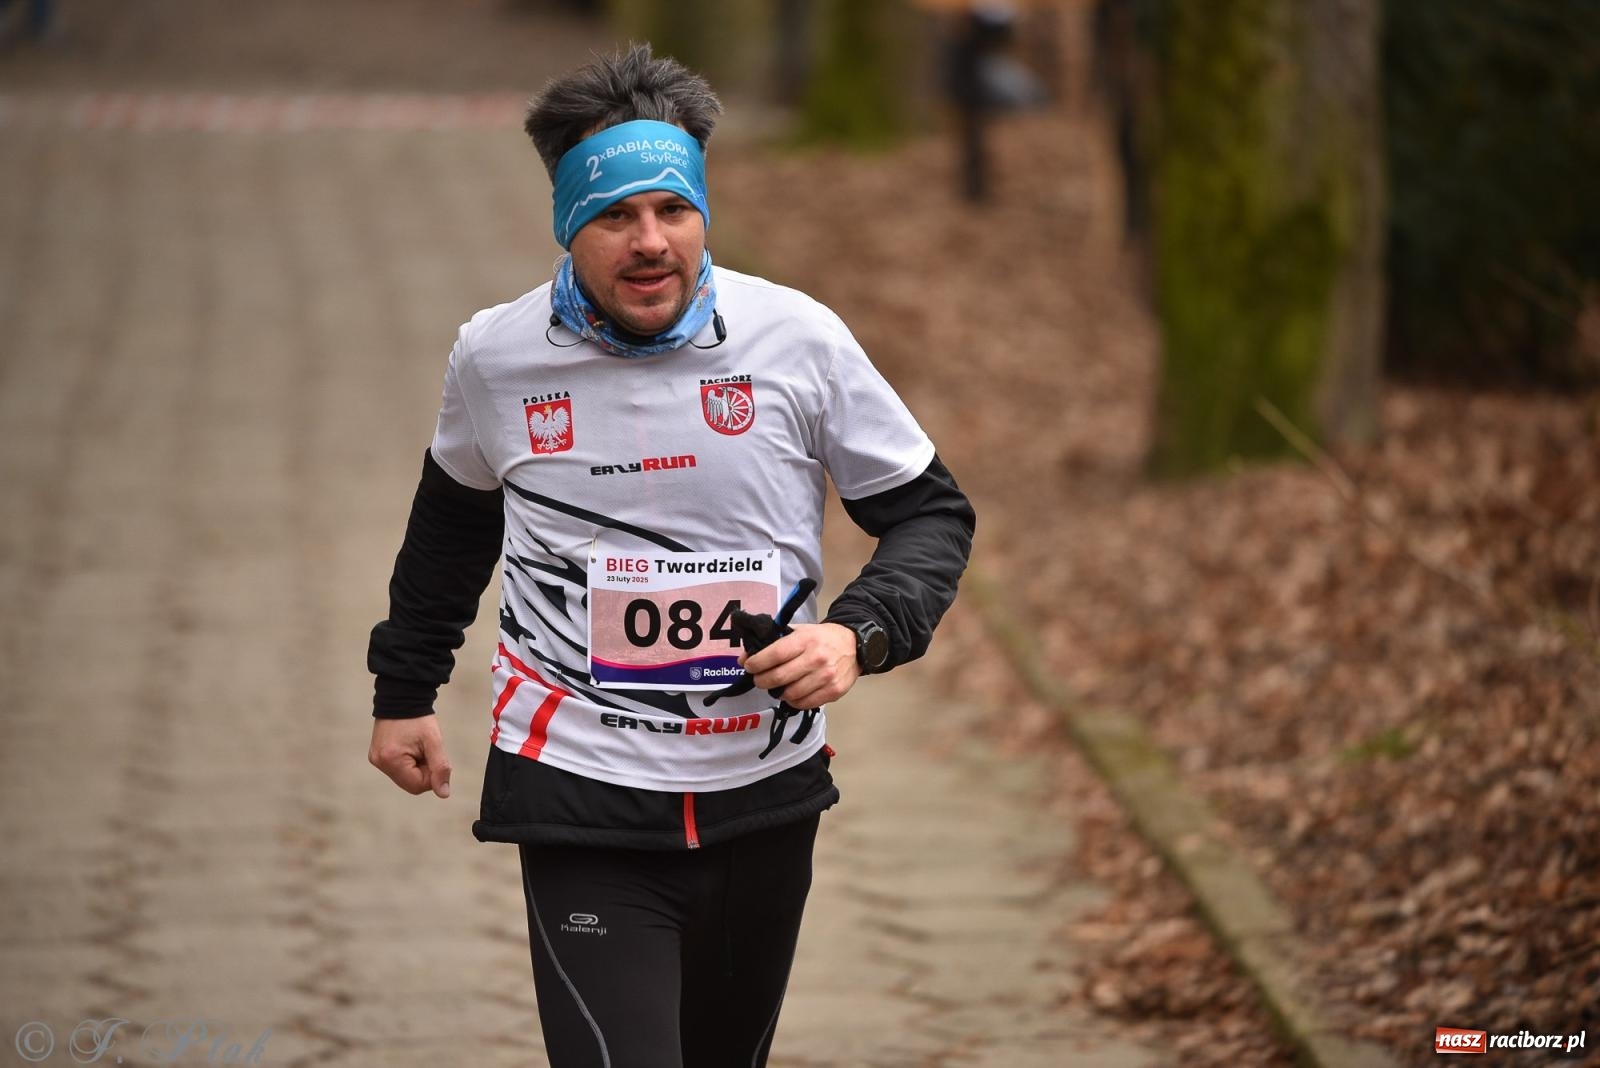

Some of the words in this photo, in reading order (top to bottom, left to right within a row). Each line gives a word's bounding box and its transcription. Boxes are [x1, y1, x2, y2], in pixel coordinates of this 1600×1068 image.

[655, 139, 689, 156] GÓRA
[700, 374, 752, 385] RACIBÓRZ
[523, 391, 571, 405] POLSKA
[606, 557, 649, 573] BIEG
[655, 557, 763, 574] Twardziela
[616, 575, 631, 583] luty
[624, 598, 742, 650] 084
[703, 667, 745, 677] Racibórz
[561, 924, 607, 936] Kalenji
